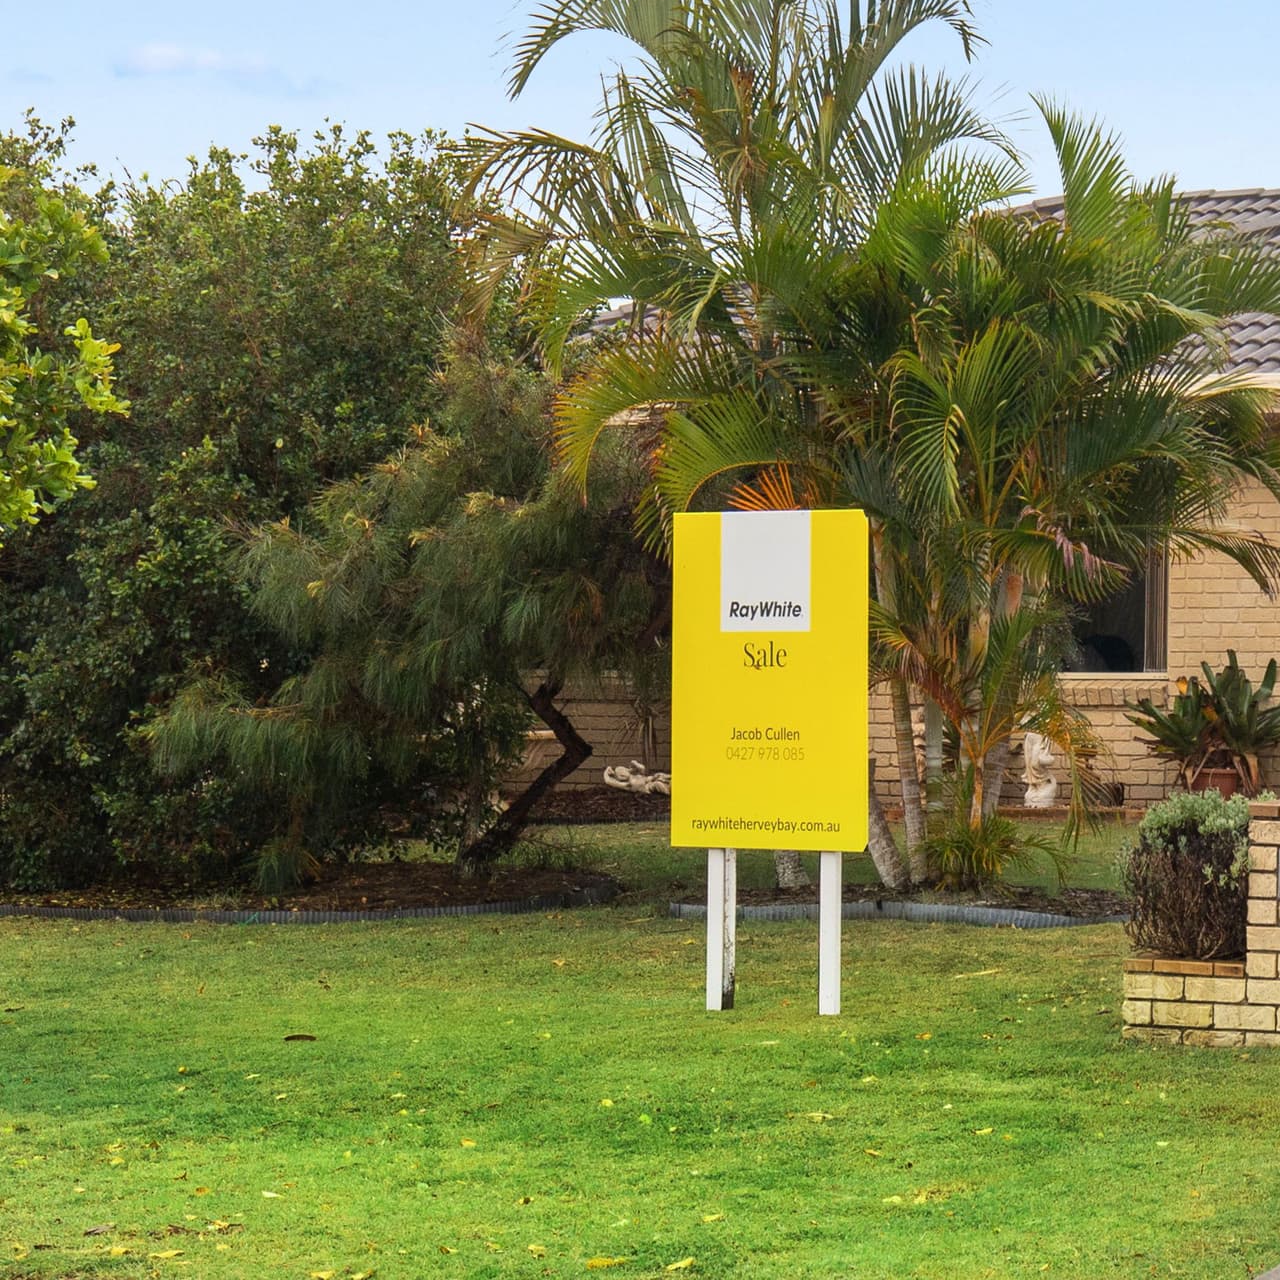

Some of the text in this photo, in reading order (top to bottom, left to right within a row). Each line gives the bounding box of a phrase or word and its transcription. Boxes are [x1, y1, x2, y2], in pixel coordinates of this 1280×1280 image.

[729, 601, 802, 621] RayWhite
[743, 640, 787, 670] Sale
[730, 727, 800, 741] Jacob Cullen
[726, 746, 805, 761] 0427 978 085
[691, 817, 840, 833] raywhiteherveybay.com.au
